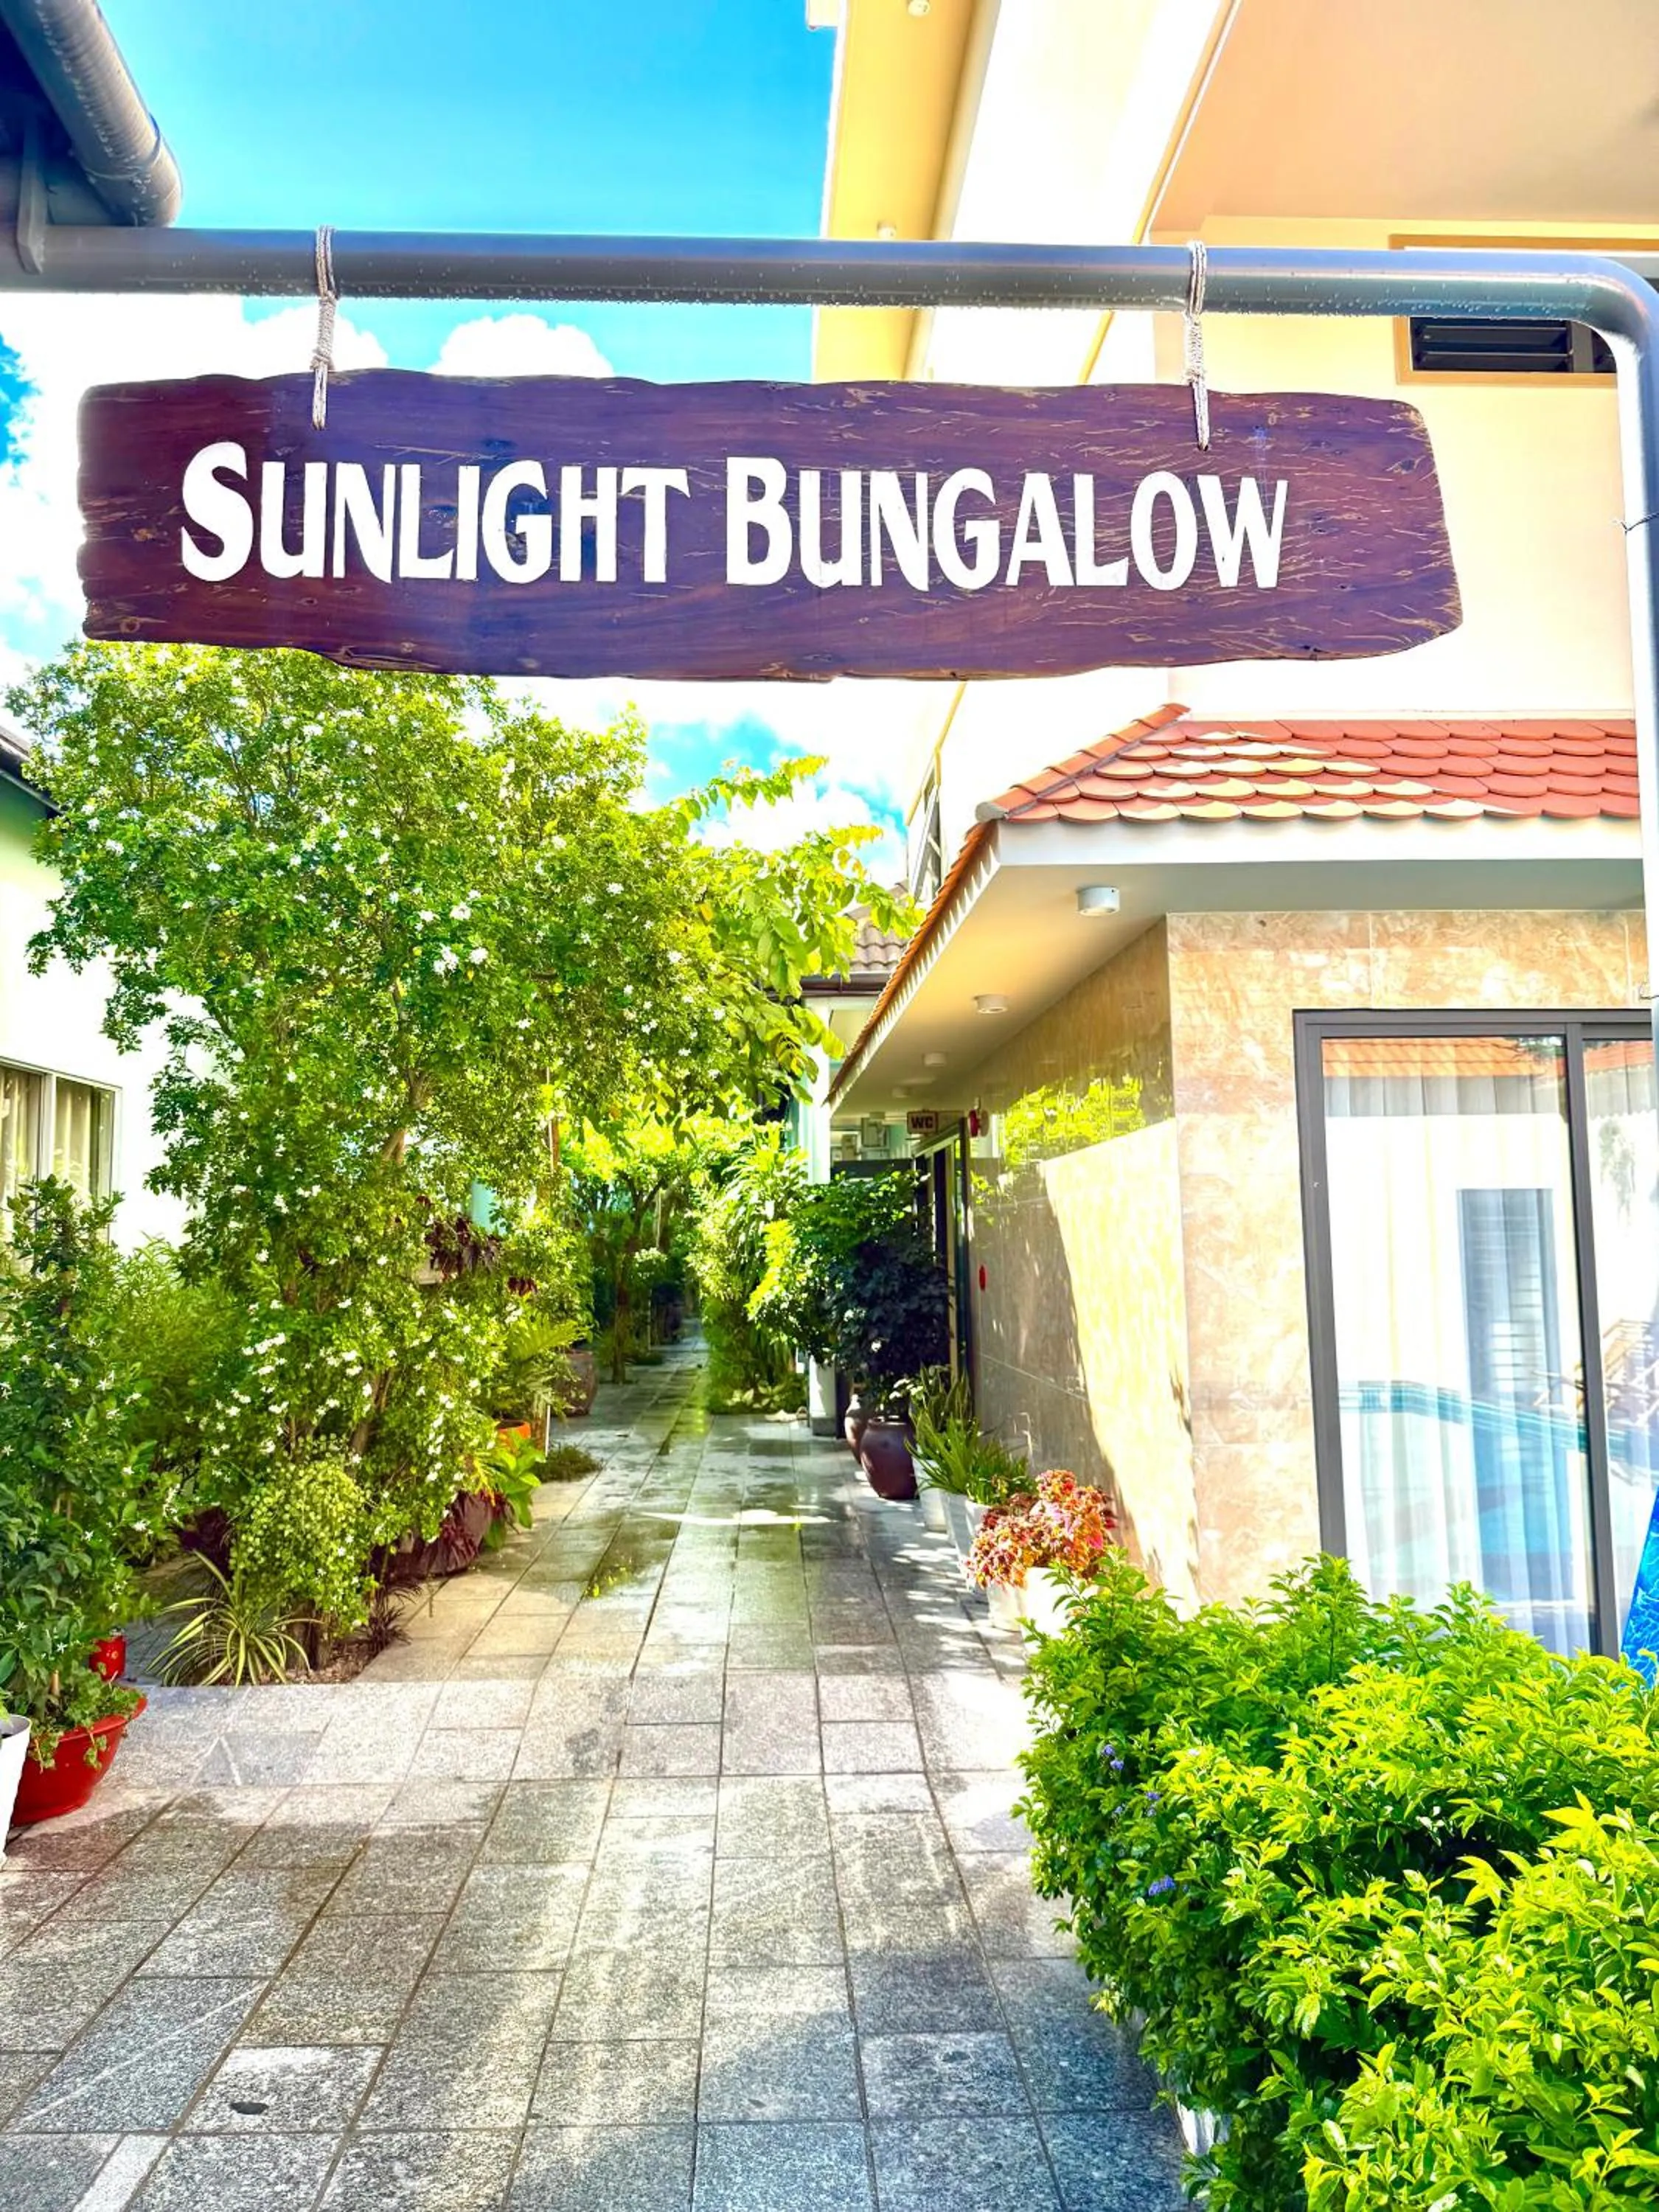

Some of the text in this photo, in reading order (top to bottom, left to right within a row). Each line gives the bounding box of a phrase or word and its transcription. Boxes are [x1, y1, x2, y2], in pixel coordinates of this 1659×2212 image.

[180, 441, 1289, 592] SUNLIGHT BUNGALOW
[911, 1116, 933, 1129] WC
